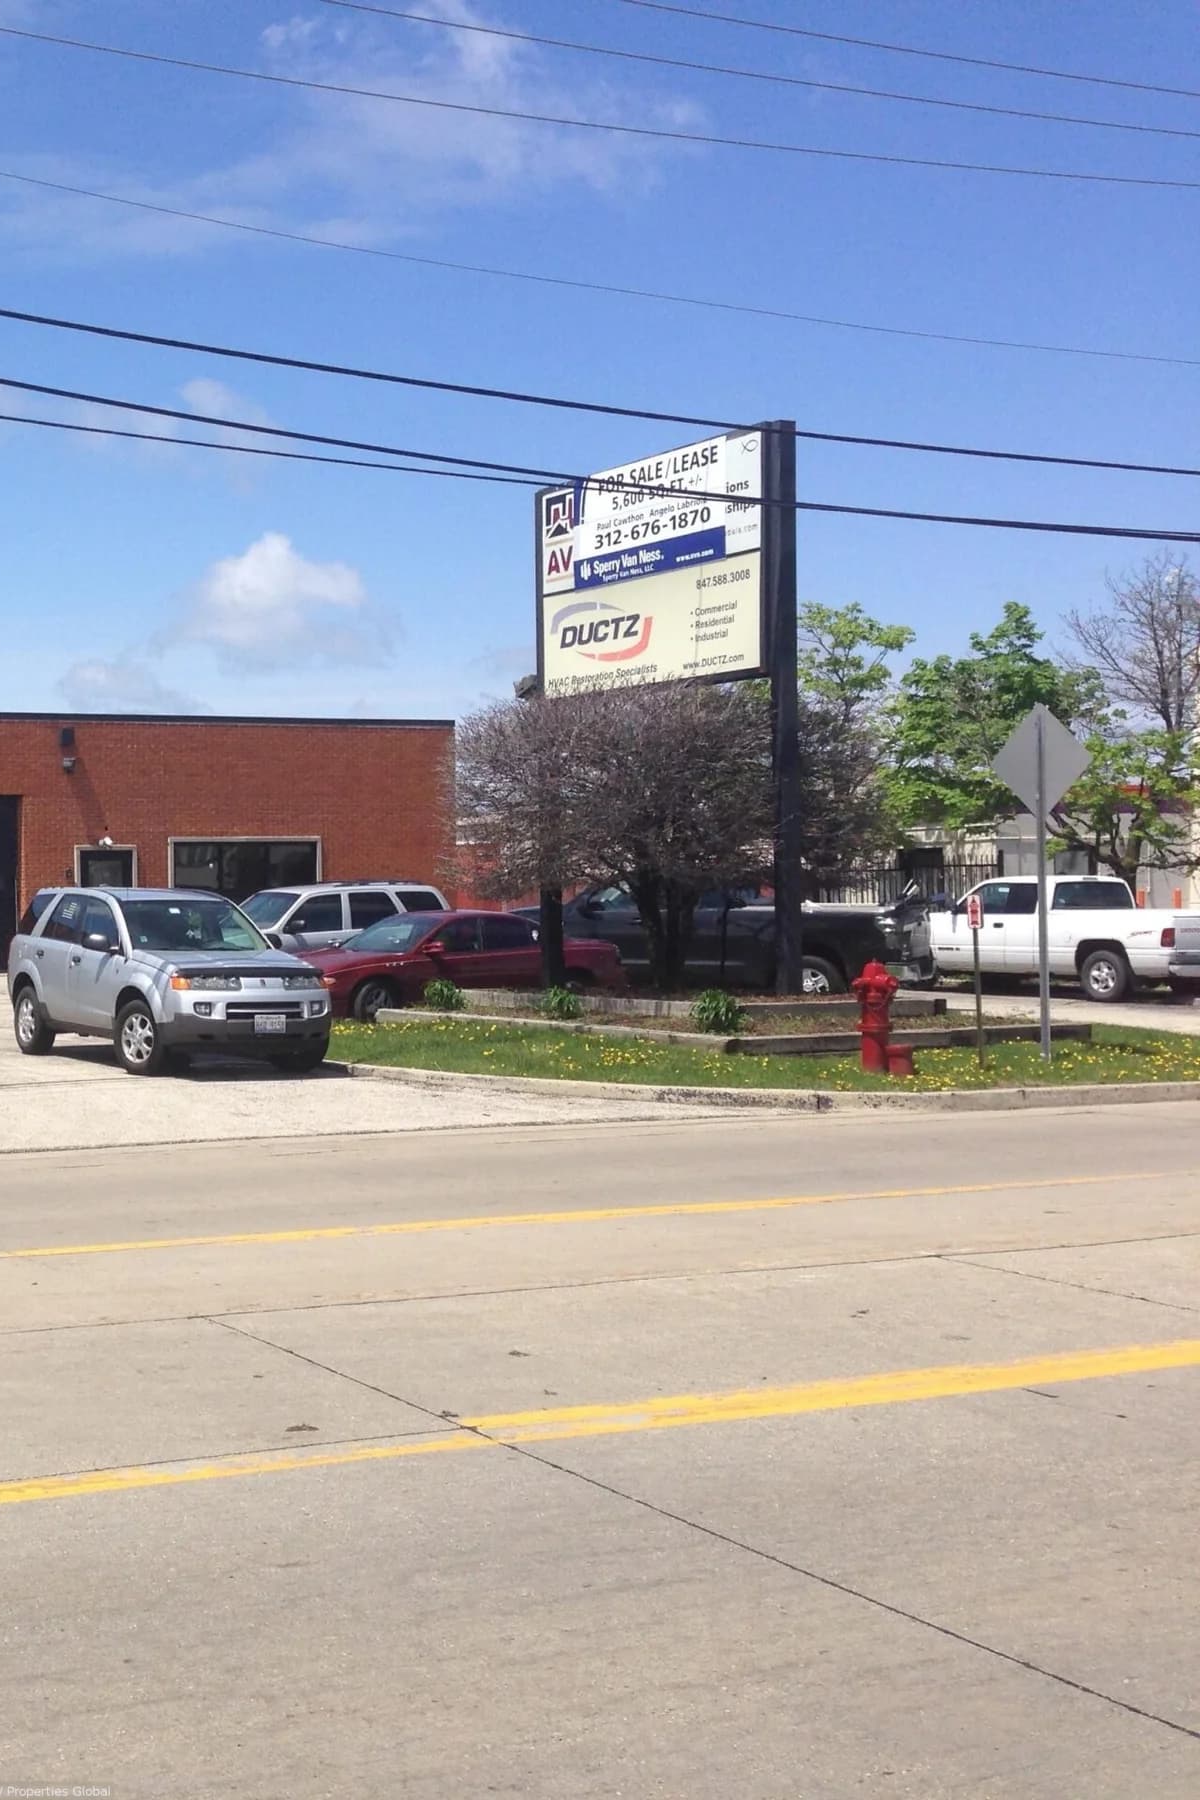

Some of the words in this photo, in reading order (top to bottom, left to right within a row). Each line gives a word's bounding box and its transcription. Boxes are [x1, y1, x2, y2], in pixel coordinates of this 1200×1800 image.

[597, 473, 625, 496] FOR
[725, 480, 750, 494] ions
[611, 489, 645, 512] 5,600
[594, 506, 711, 550] 312-676-1870
[596, 519, 612, 531] Paul
[613, 512, 645, 528] Cawthon
[649, 502, 675, 518] Angelo
[547, 545, 574, 576] AV
[592, 559, 621, 577] Sperry
[620, 553, 638, 568] Van
[602, 573, 619, 582] Sperry
[619, 569, 630, 578] Van
[644, 563, 655, 573] LLC
[696, 568, 751, 590] 847.588.3008
[695, 600, 737, 616] Commercial
[560, 613, 641, 650] DUCTZ
[695, 615, 735, 630] Residential
[695, 629, 729, 642] Industrial
[683, 653, 745, 670] www.DUCTZ.com
[547, 676, 570, 689] HVAC
[571, 671, 615, 685] Restoration
[615, 663, 658, 678] Specialists
